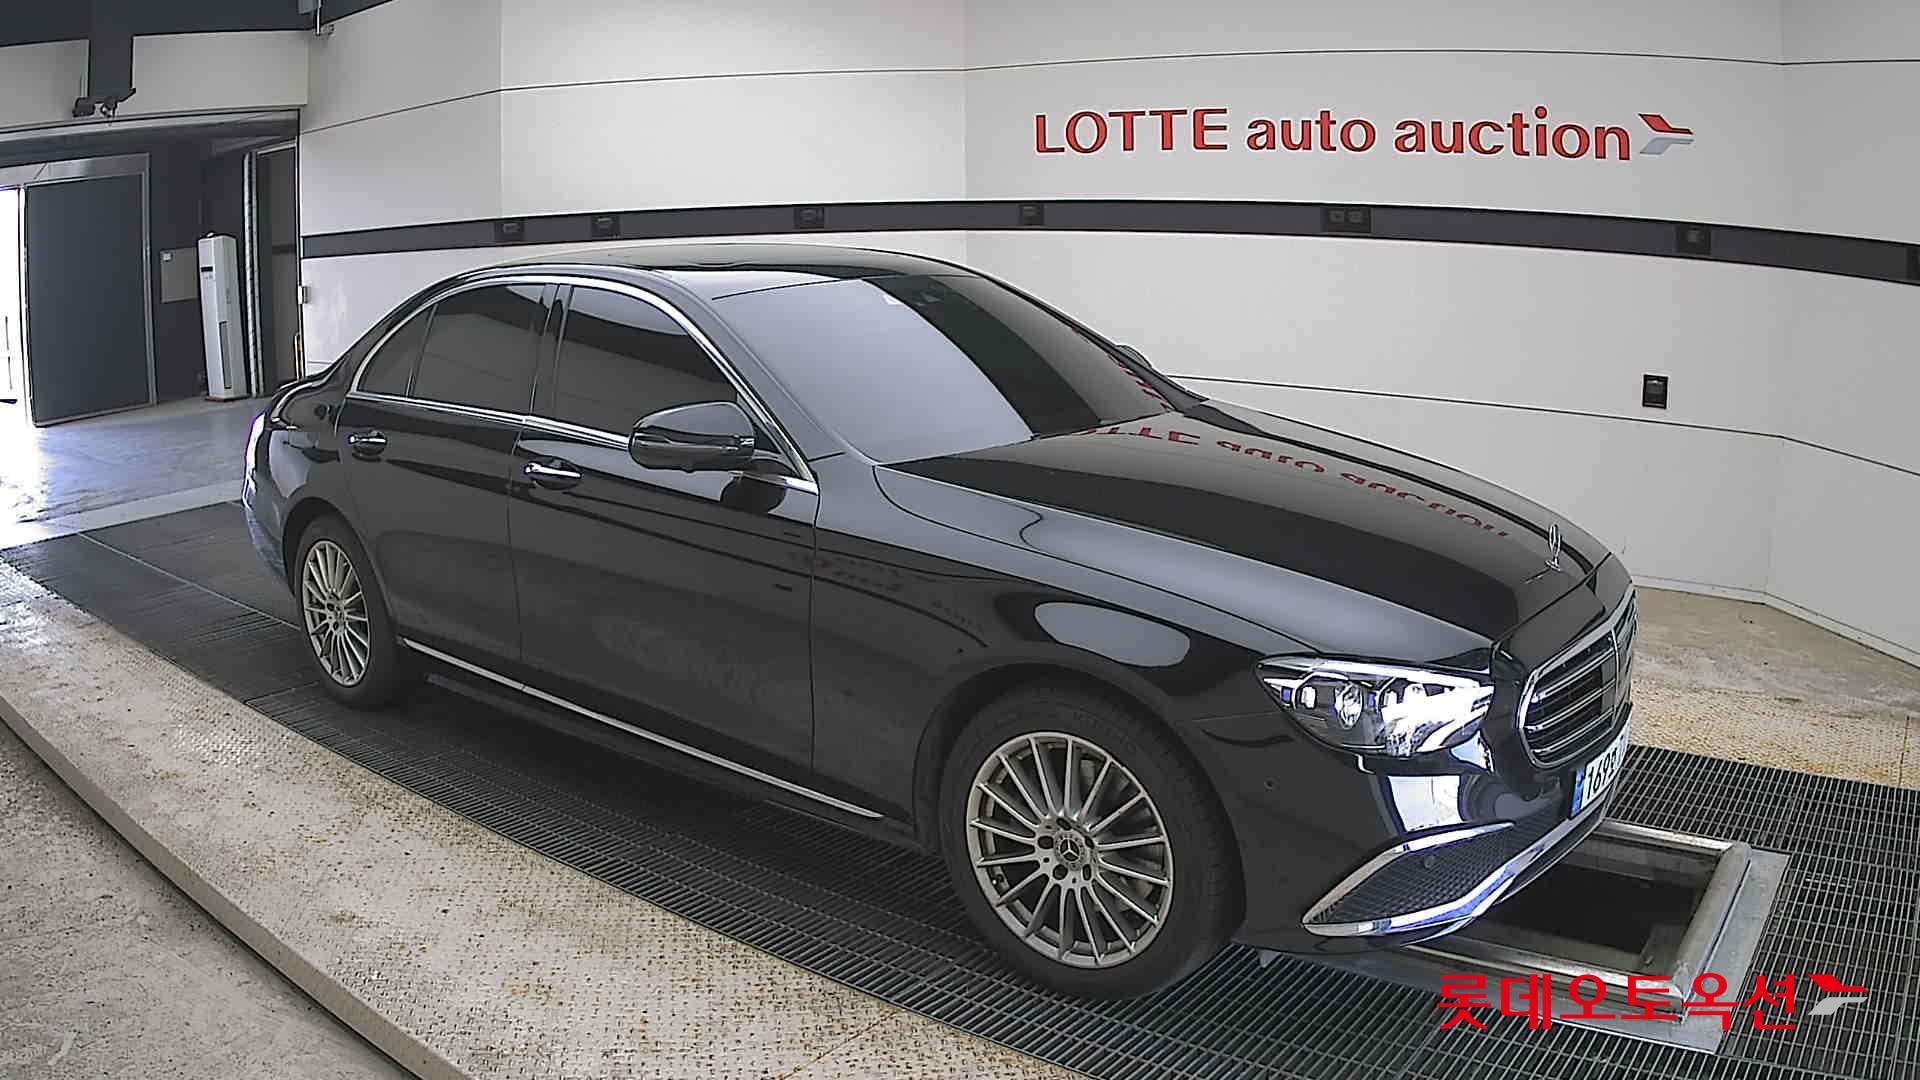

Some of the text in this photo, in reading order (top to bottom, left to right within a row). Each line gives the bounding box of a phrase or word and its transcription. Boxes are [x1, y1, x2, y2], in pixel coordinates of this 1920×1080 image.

[1034, 105, 1632, 161] LOTTE auto auction
